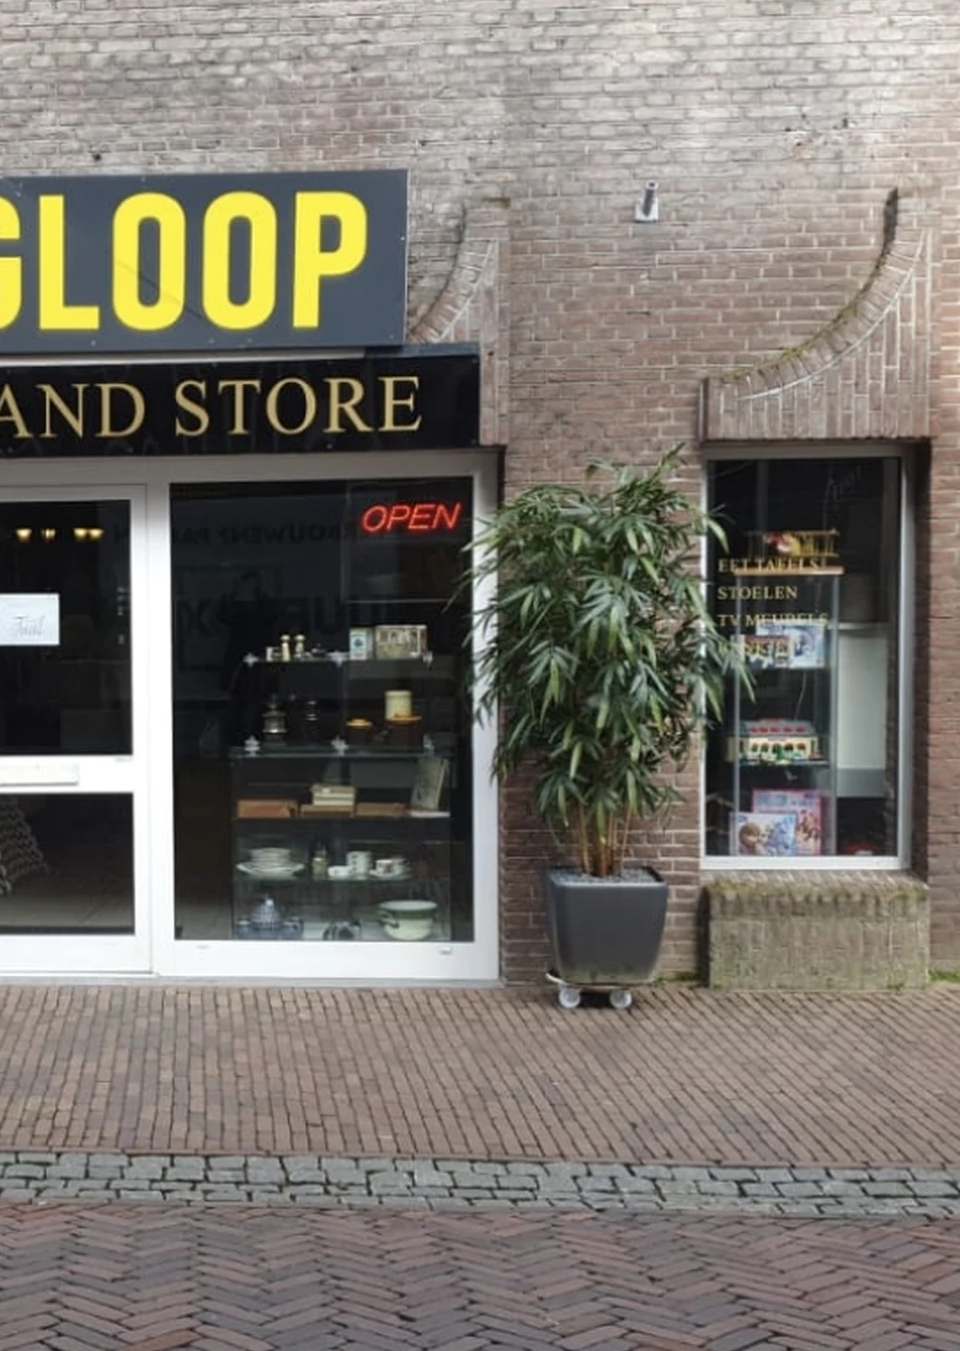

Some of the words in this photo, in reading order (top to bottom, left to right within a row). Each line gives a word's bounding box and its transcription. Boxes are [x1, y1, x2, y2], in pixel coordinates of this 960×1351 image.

[174, 375, 423, 437] STORE
[361, 501, 462, 533] OPEN
[718, 585, 797, 601] STOELEN
[717, 613, 741, 627] TV
